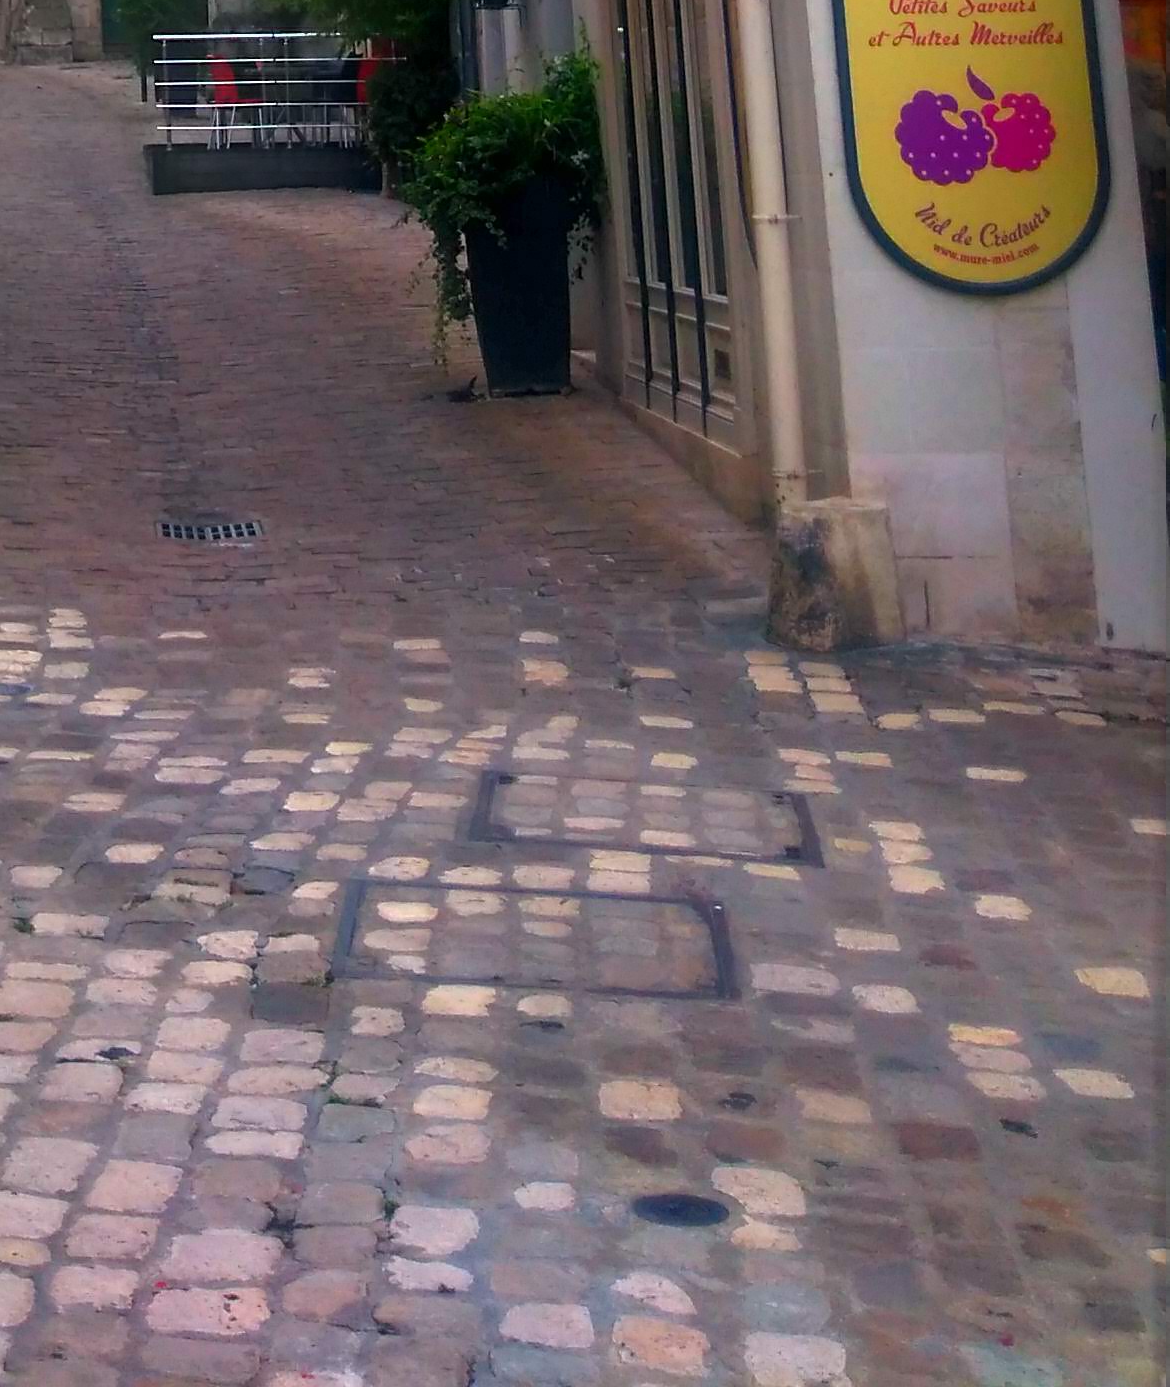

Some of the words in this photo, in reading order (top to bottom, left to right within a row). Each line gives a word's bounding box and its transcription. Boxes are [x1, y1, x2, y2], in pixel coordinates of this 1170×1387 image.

[867, 30, 890, 48] et
[892, 21, 960, 47] Autres
[969, 20, 1064, 46] Merveilles
[914, 202, 951, 236] Nid
[951, 225, 973, 246] de
[933, 242, 1040, 265] www.mure-miel.com
